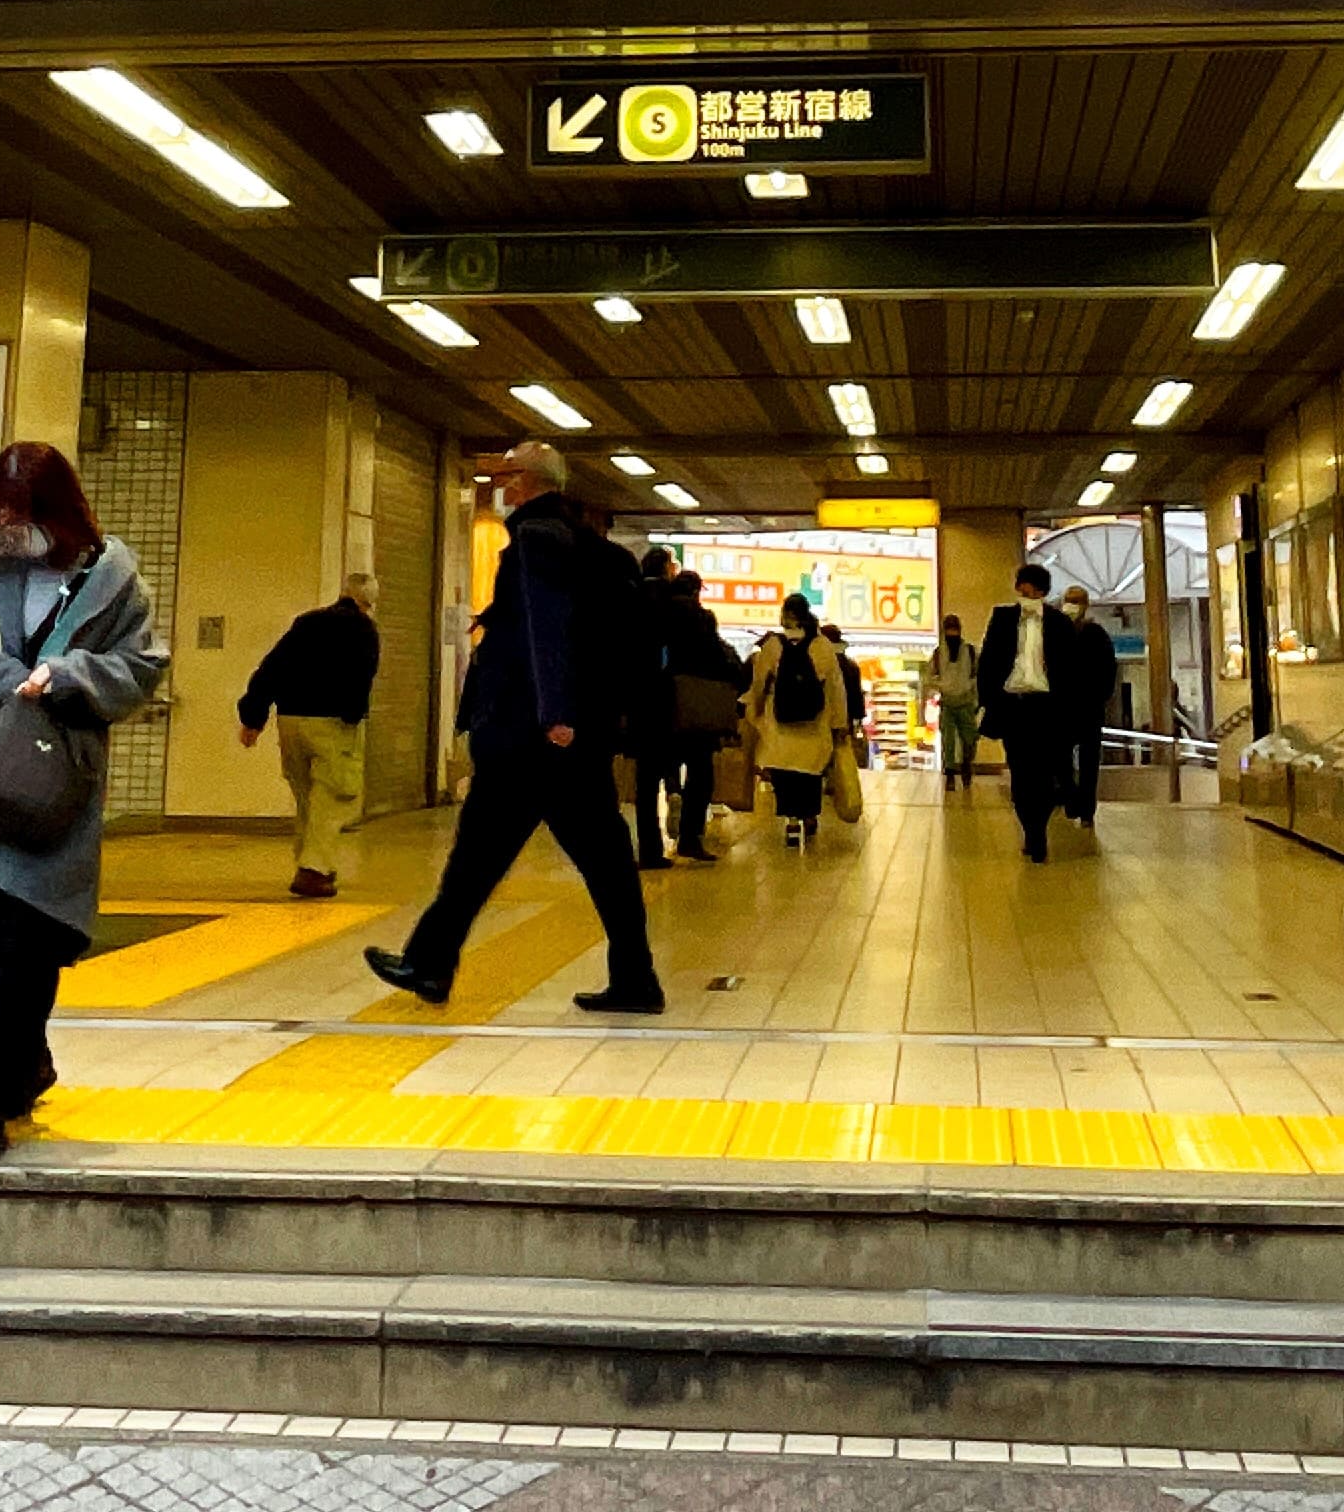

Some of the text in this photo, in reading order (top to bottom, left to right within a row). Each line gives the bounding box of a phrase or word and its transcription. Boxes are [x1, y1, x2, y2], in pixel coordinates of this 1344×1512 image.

[700, 89, 872, 122] 都営新宿線
[651, 112, 666, 135] S
[701, 122, 823, 141] Shinjuku Line
[700, 142, 745, 158] 100m
